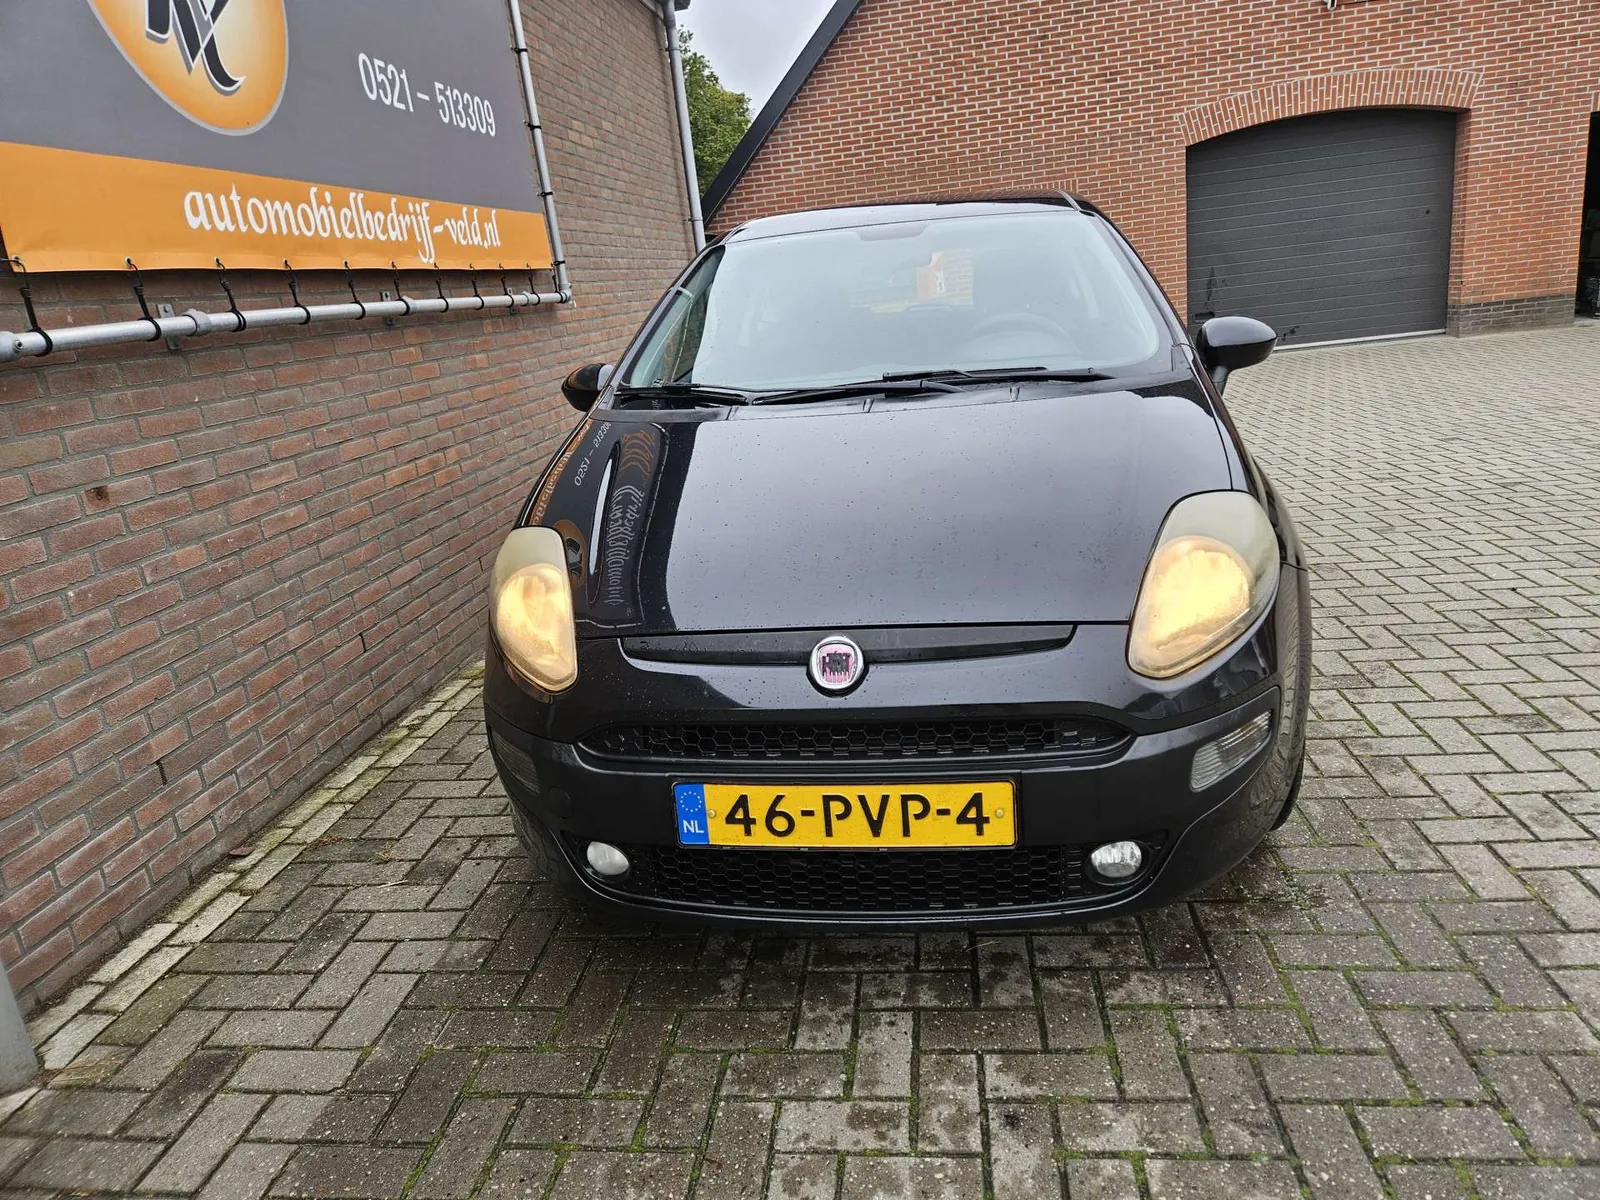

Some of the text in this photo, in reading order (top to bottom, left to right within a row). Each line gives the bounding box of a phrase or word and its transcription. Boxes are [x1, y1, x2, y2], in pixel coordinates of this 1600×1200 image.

[358, 53, 414, 112] 0521
[434, 81, 496, 137] 513309
[184, 184, 501, 263] automobielbedrijf-veld.nl
[683, 819, 705, 834] NL
[725, 792, 990, 838] 46-PVP-4
